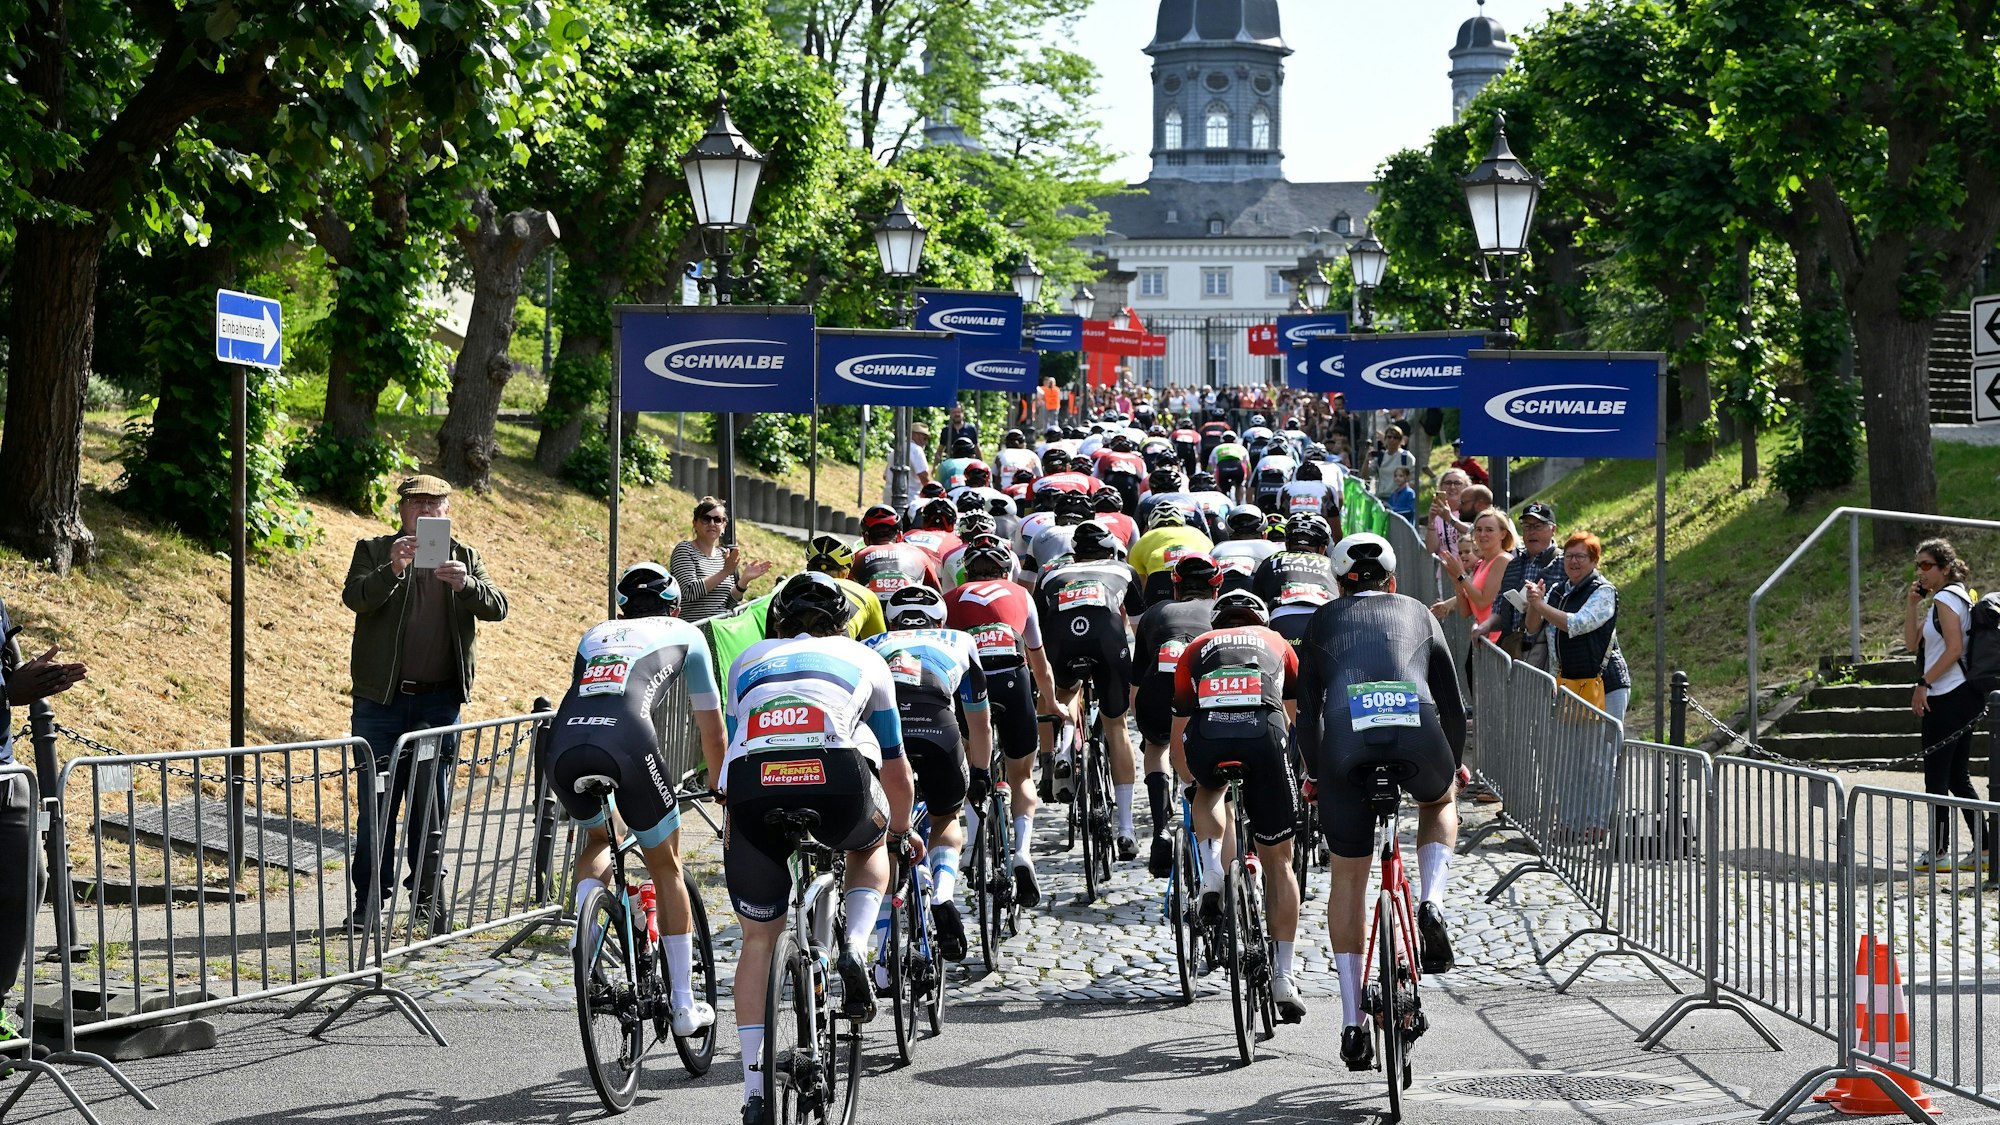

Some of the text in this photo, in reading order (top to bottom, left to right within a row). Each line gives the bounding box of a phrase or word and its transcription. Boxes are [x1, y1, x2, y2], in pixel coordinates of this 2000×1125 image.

[943, 315, 1006, 326] SCHWALBE
[222, 318, 265, 338] Einbahnstraße
[669, 354, 785, 370] SCHWALBE
[853, 363, 936, 377] SCHWALBE
[976, 365, 1026, 375] SCHWALBE
[1379, 366, 1462, 379] SCHWALBE
[1510, 400, 1626, 415] SCHWALBE
[864, 550, 899, 564] sebam
[1270, 555, 1331, 571] TEAM
[876, 578, 905, 589] 5824
[583, 663, 625, 679] 5870
[1209, 677, 1248, 691] 5141
[640, 663, 674, 721] STRASSACKER
[1362, 691, 1407, 709] 5089
[567, 716, 618, 726] CUBE
[758, 707, 809, 729] 6802
[645, 753, 674, 808] STRASSACKER
[763, 773, 820, 783] Mietgeräte
